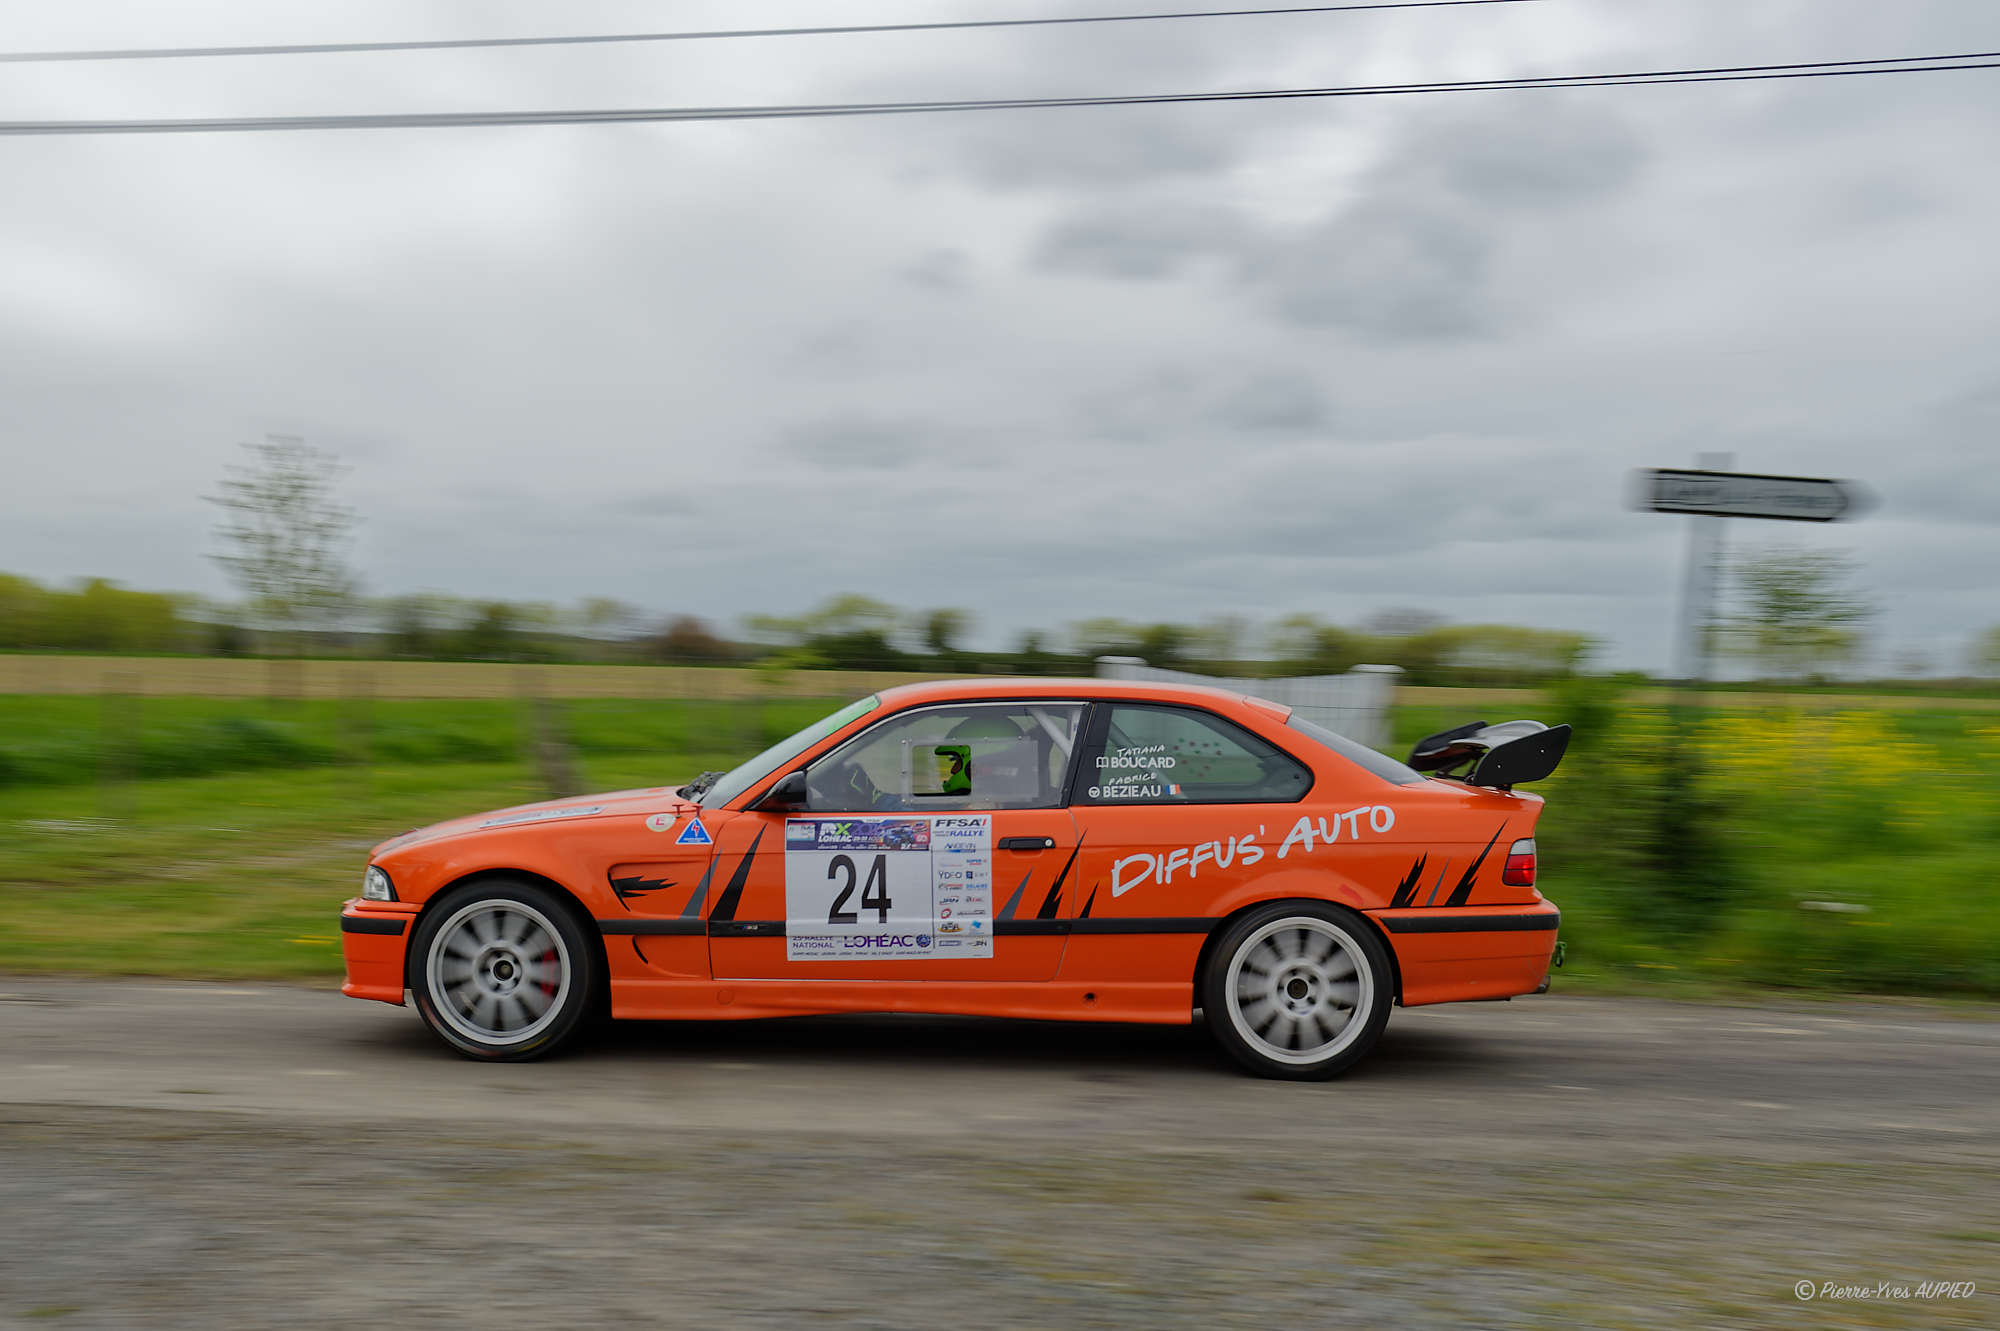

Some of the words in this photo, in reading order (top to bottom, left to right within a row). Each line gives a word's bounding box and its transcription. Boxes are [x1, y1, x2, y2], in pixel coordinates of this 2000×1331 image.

[1116, 744, 1166, 757] TATIANA
[1111, 756, 1176, 769] BOUCARD
[1108, 772, 1158, 786] FABRICE
[1102, 784, 1161, 798] BEZIEAU
[935, 818, 981, 827] FFSA
[1111, 824, 1265, 898] DIFFUS'
[1276, 805, 1396, 860] AUTO
[827, 853, 892, 925] 24
[792, 941, 834, 949] NATIONAL
[843, 933, 914, 948] LOHÉAC
